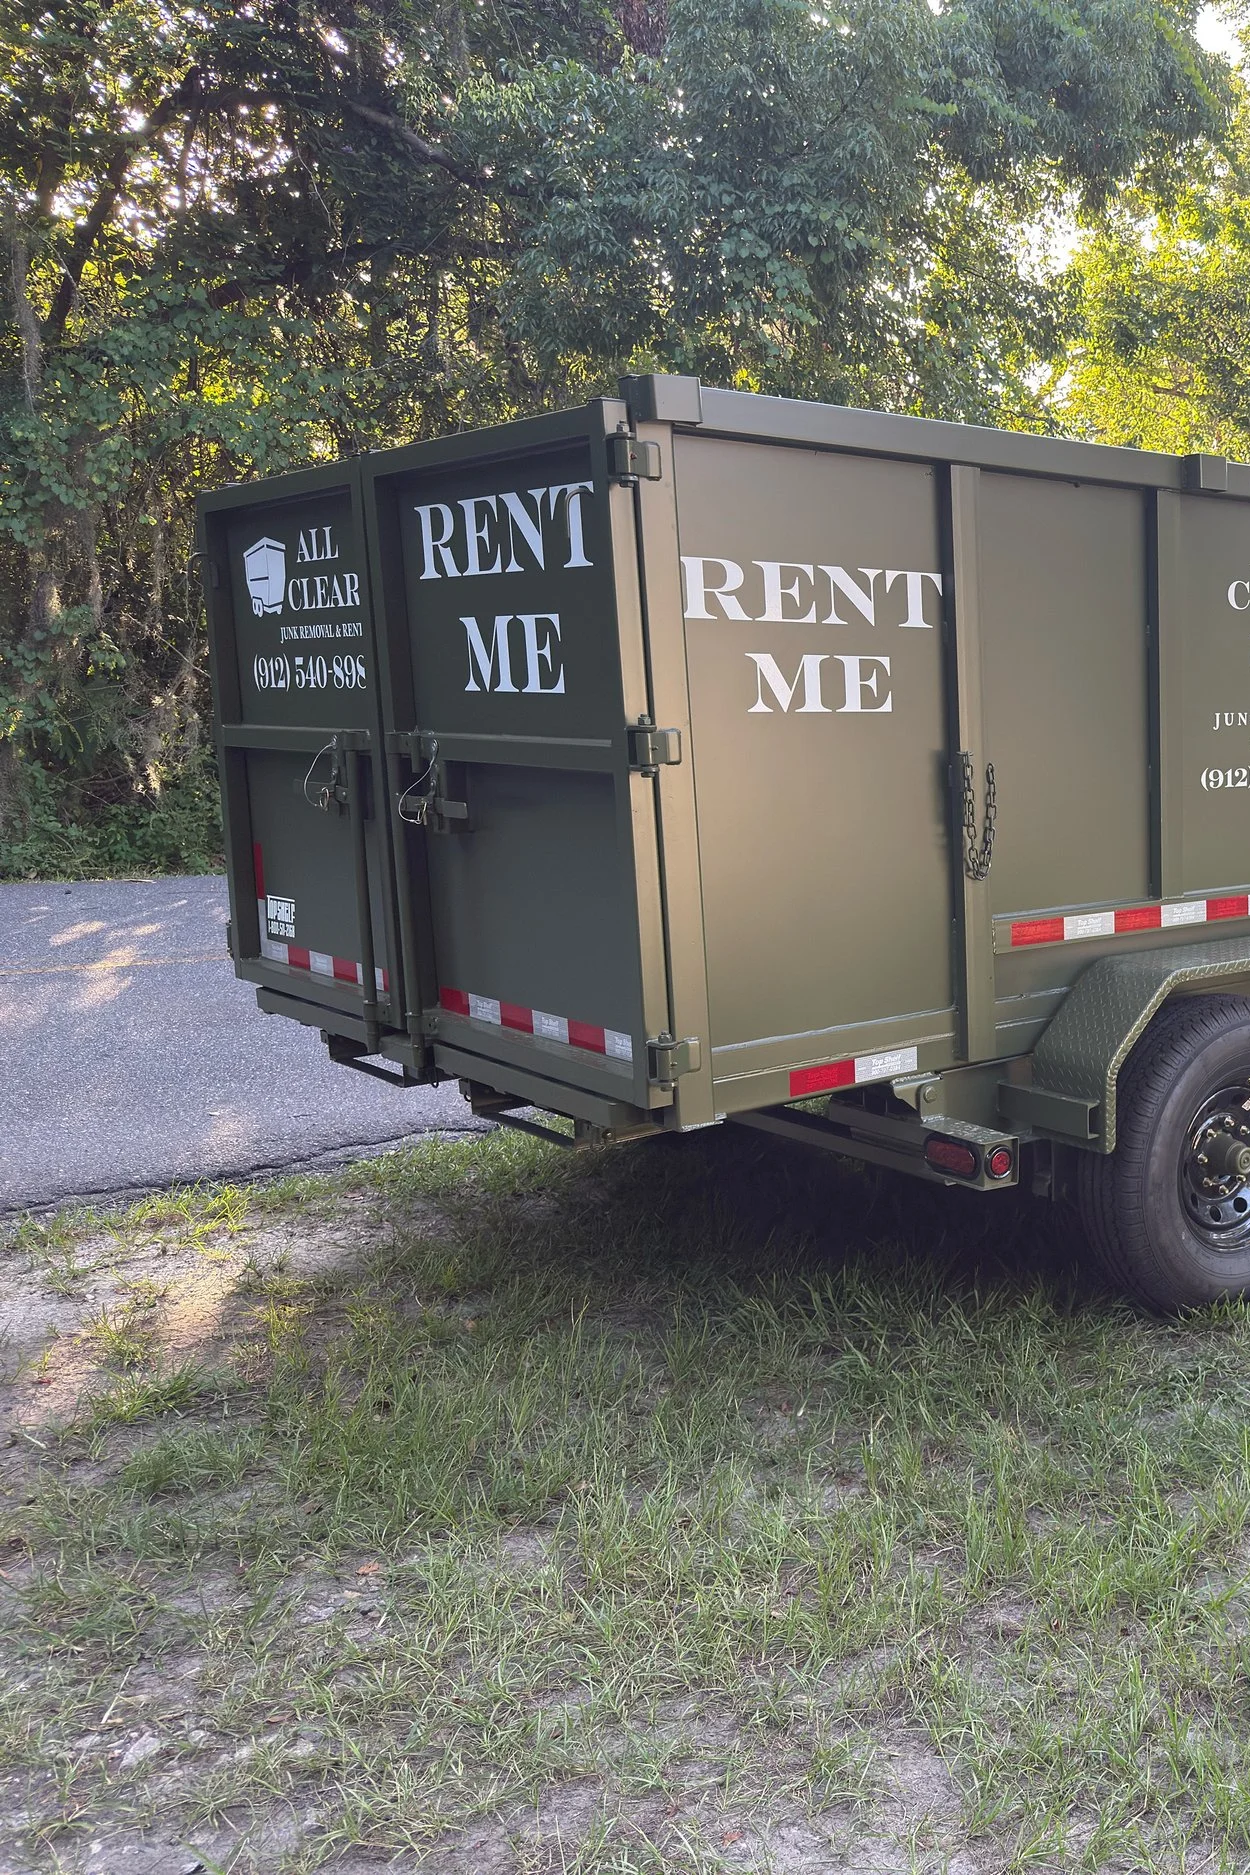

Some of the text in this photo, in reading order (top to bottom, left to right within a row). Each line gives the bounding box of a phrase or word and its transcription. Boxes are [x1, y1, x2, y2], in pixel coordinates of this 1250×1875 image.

[296, 526, 339, 563] ALL
[414, 480, 594, 580] RENT
[287, 573, 360, 611] CLEAR
[680, 555, 943, 629] RENT
[280, 626, 299, 644] JUNK
[299, 624, 334, 639] REMOVAL
[335, 624, 341, 637] &
[459, 613, 565, 693] ME
[253, 653, 291, 692] (912)
[744, 653, 893, 713] ME
